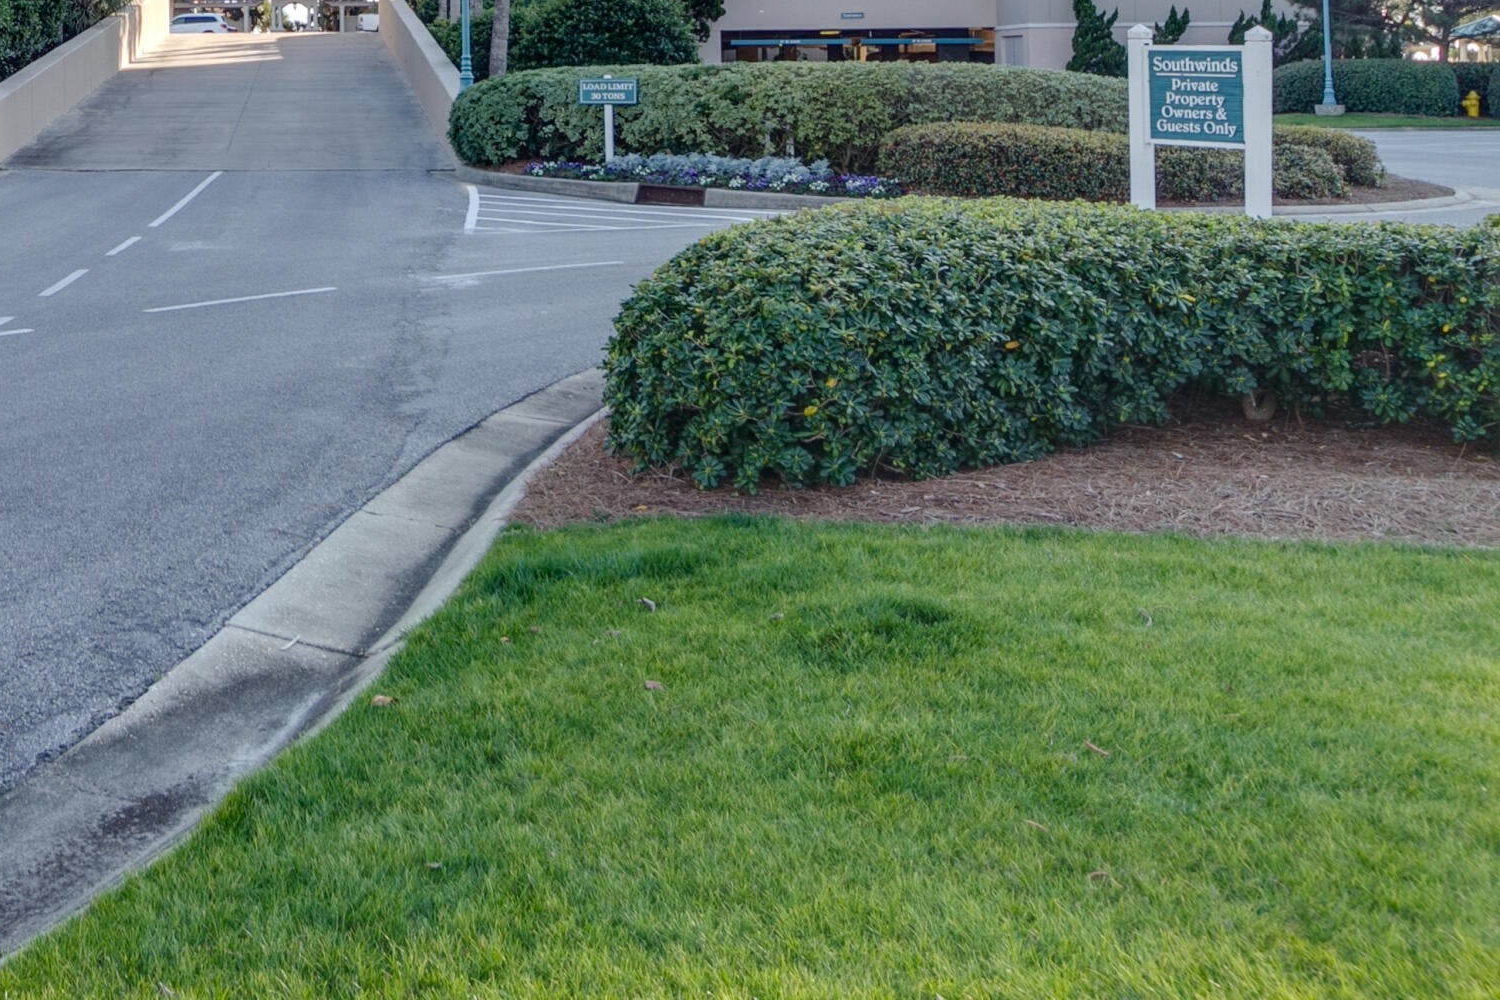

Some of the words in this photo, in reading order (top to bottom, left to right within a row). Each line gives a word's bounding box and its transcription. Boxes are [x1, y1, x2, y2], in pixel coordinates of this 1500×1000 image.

[1153, 56, 1238, 73] Southwinds
[1171, 78, 1218, 92] Private
[602, 92, 625, 100] TONS
[1166, 91, 1225, 107] Property
[1161, 105, 1213, 119] Owners
[1216, 107, 1227, 120] &
[1157, 119, 1201, 133] Guests
[1203, 121, 1237, 138] Only
